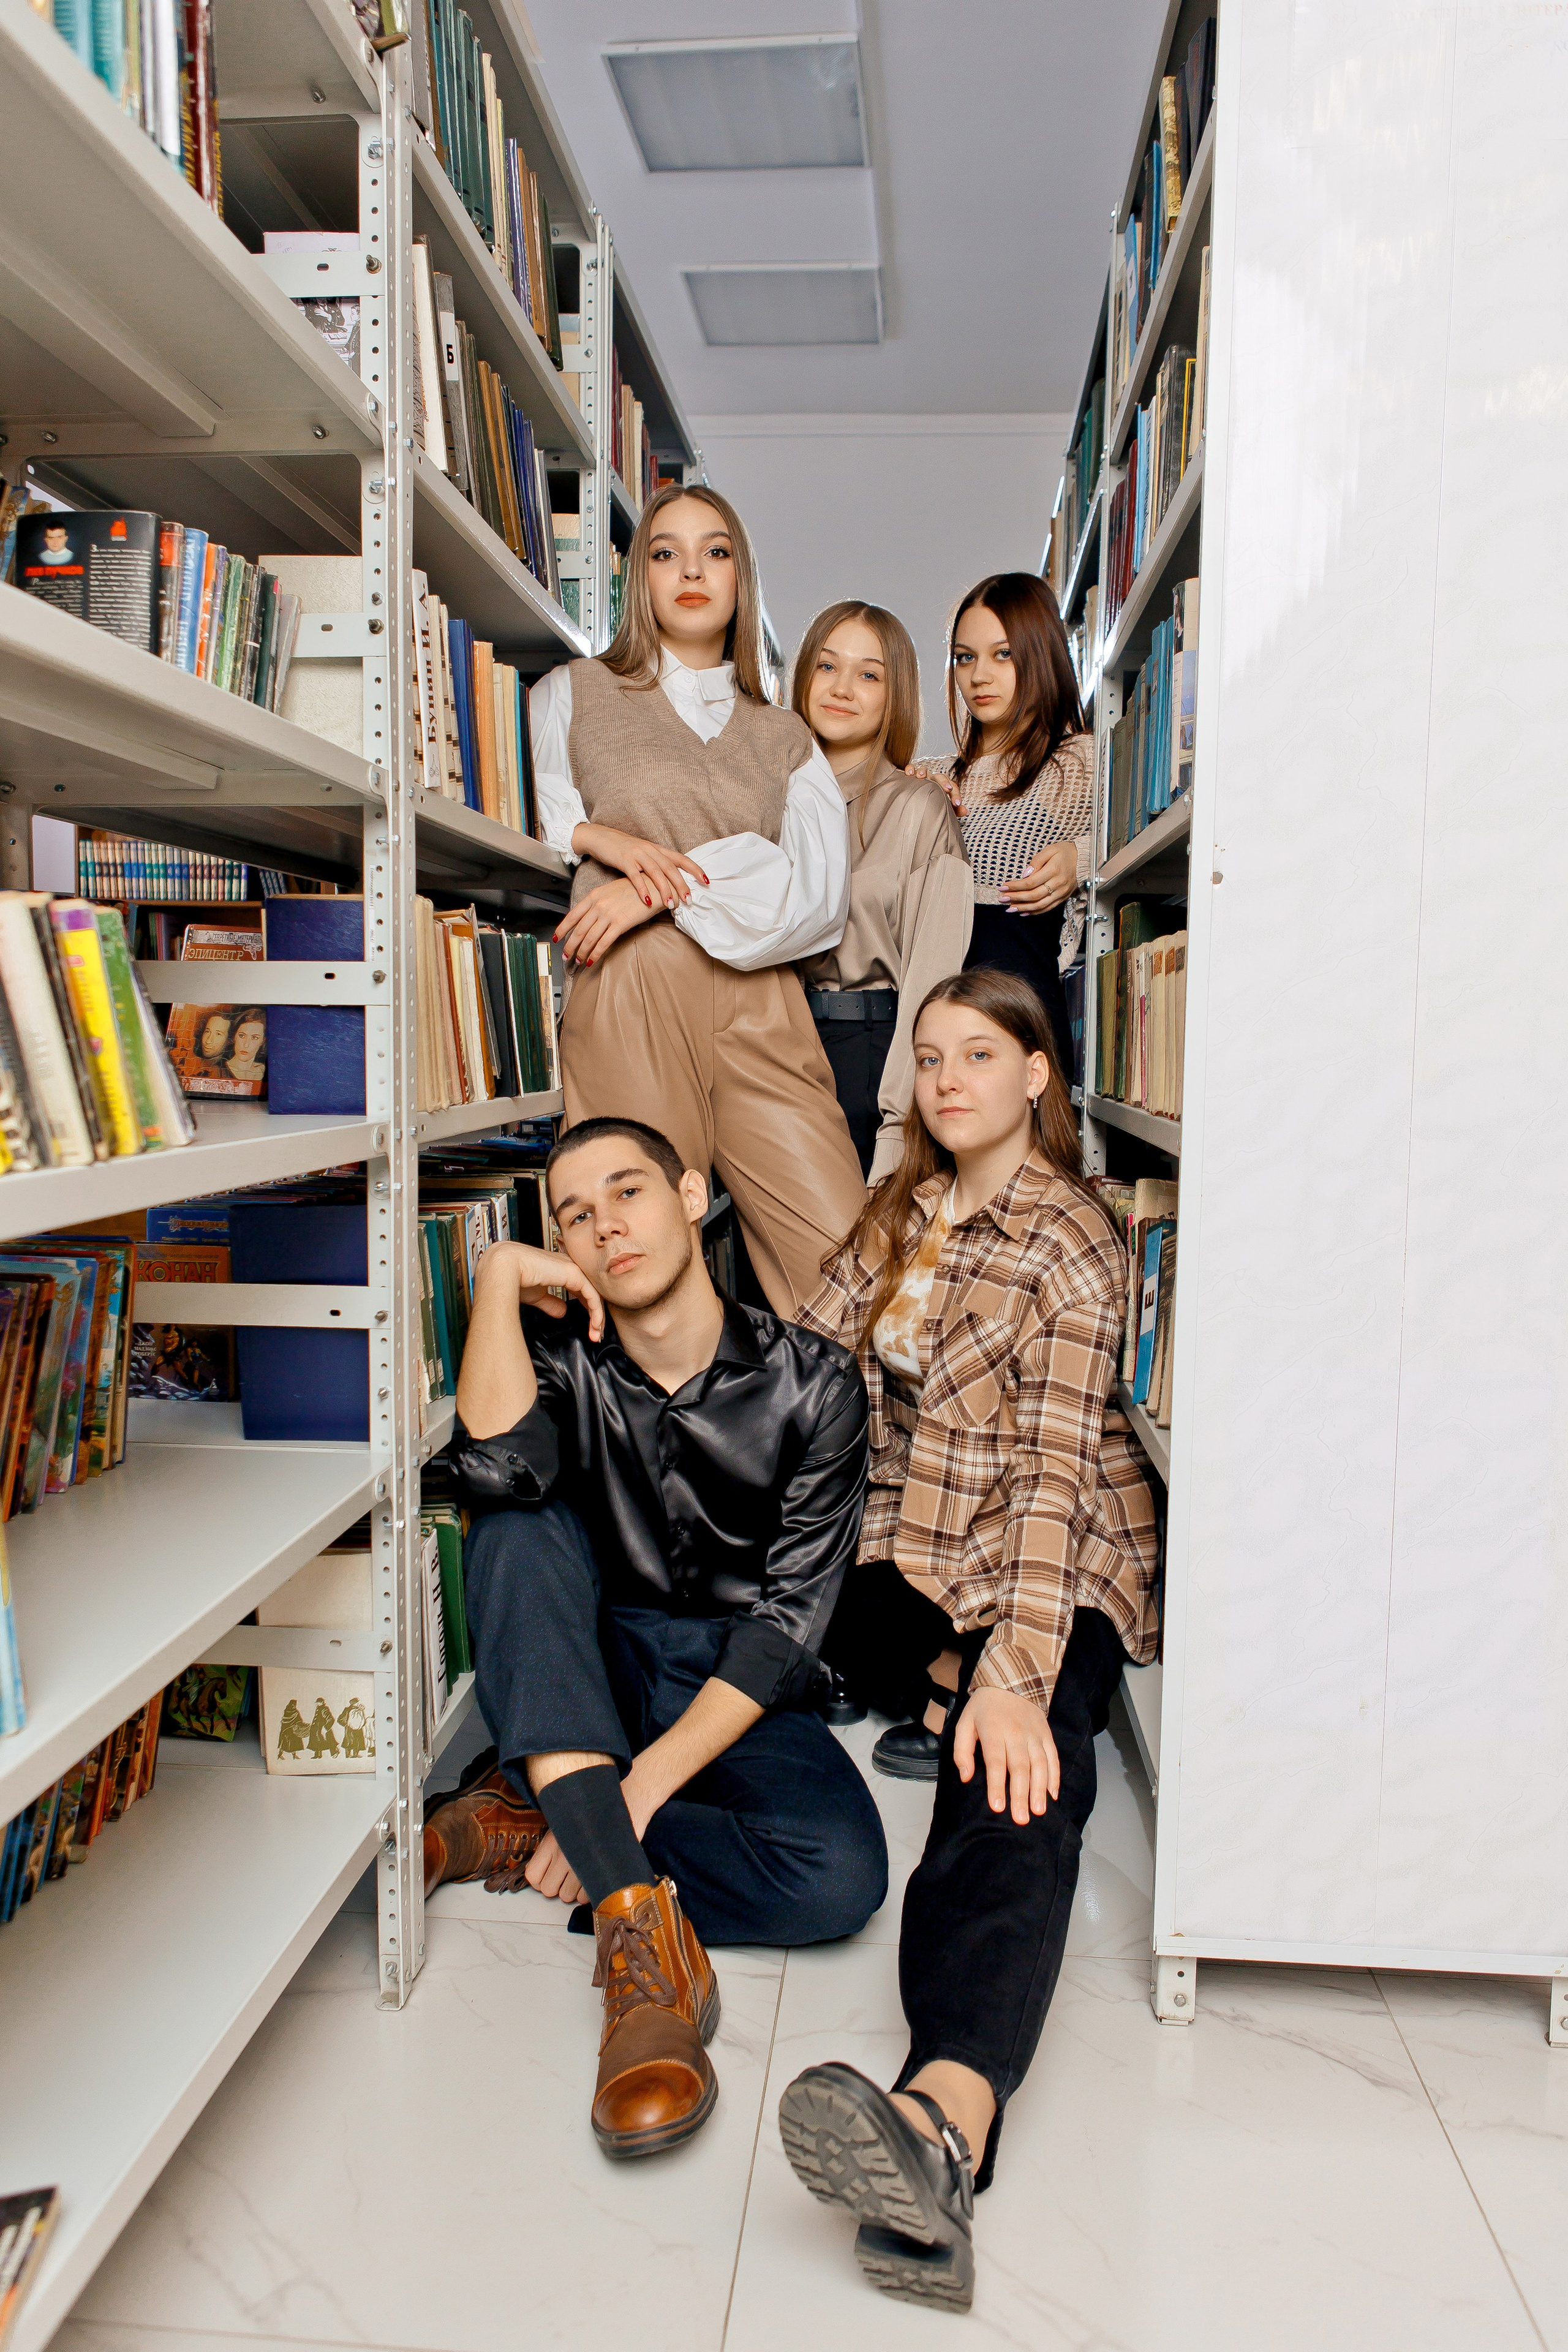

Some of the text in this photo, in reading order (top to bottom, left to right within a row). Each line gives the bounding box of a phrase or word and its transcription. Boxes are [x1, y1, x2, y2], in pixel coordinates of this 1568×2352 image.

[446, 344, 454, 364] Б
[418, 583, 437, 745] Бунин И. А.
[188, 948, 244, 961] ЭПИЦЕНТР
[135, 1260, 216, 1282] КОНАН
